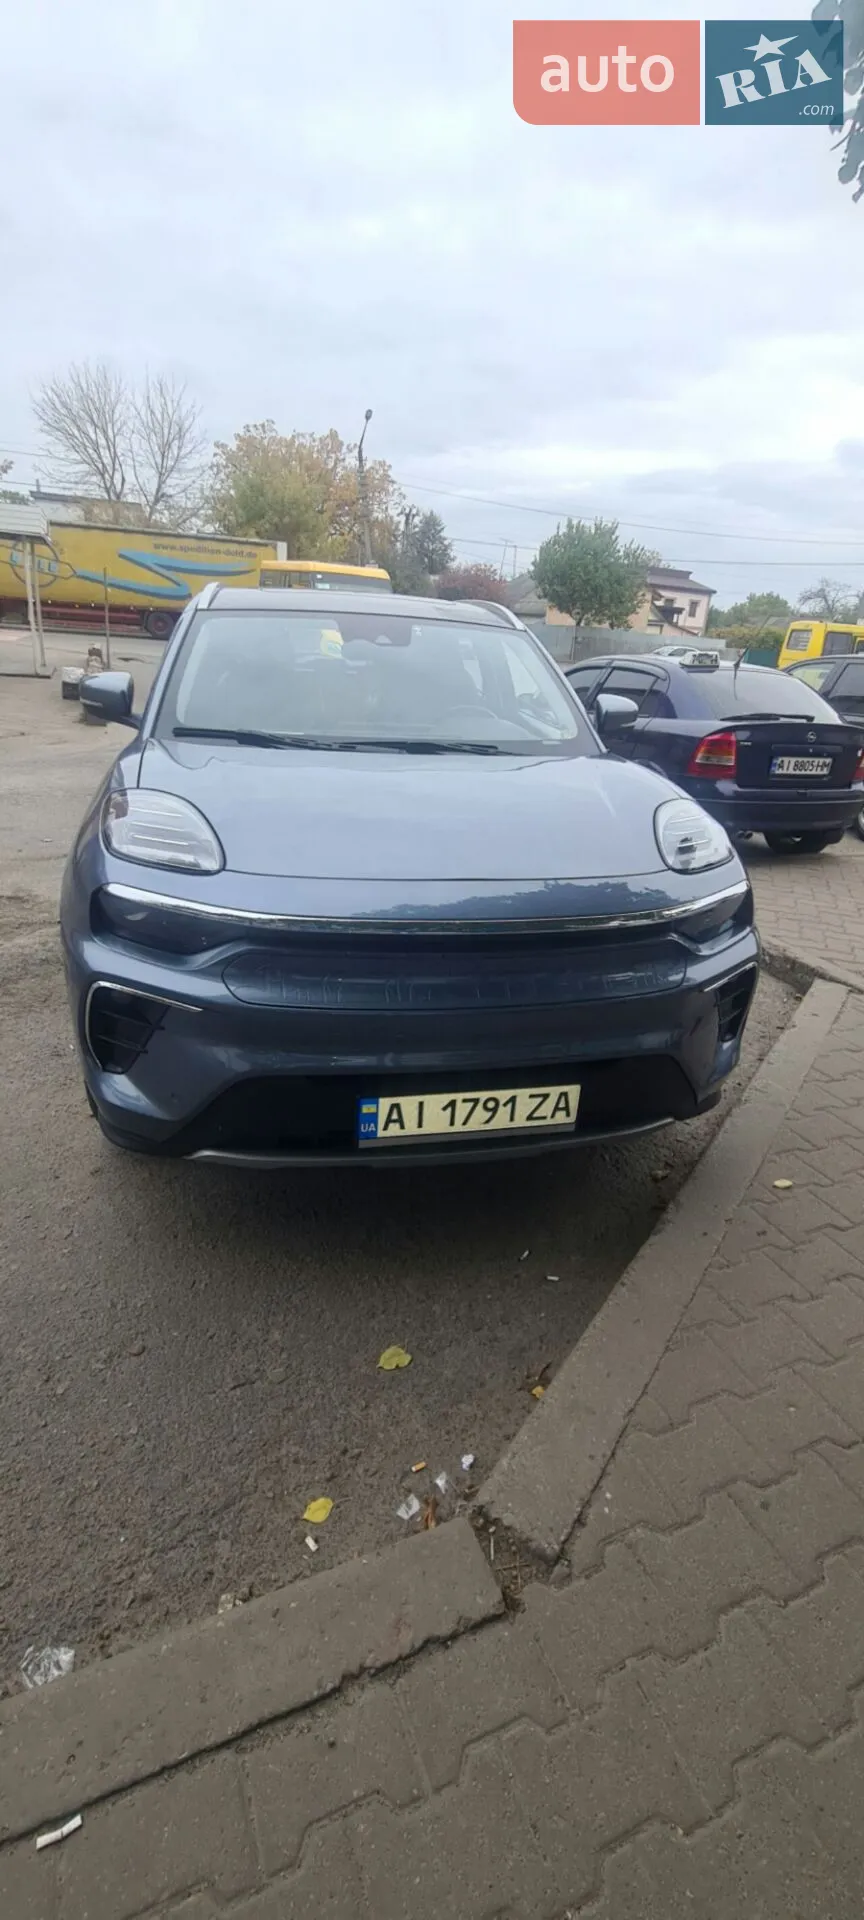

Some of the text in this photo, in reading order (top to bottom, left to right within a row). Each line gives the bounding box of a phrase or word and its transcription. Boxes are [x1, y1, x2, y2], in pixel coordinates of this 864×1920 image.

[382, 1091, 572, 1131] AI 1791 ZA
[360, 1122, 377, 1133] UA
